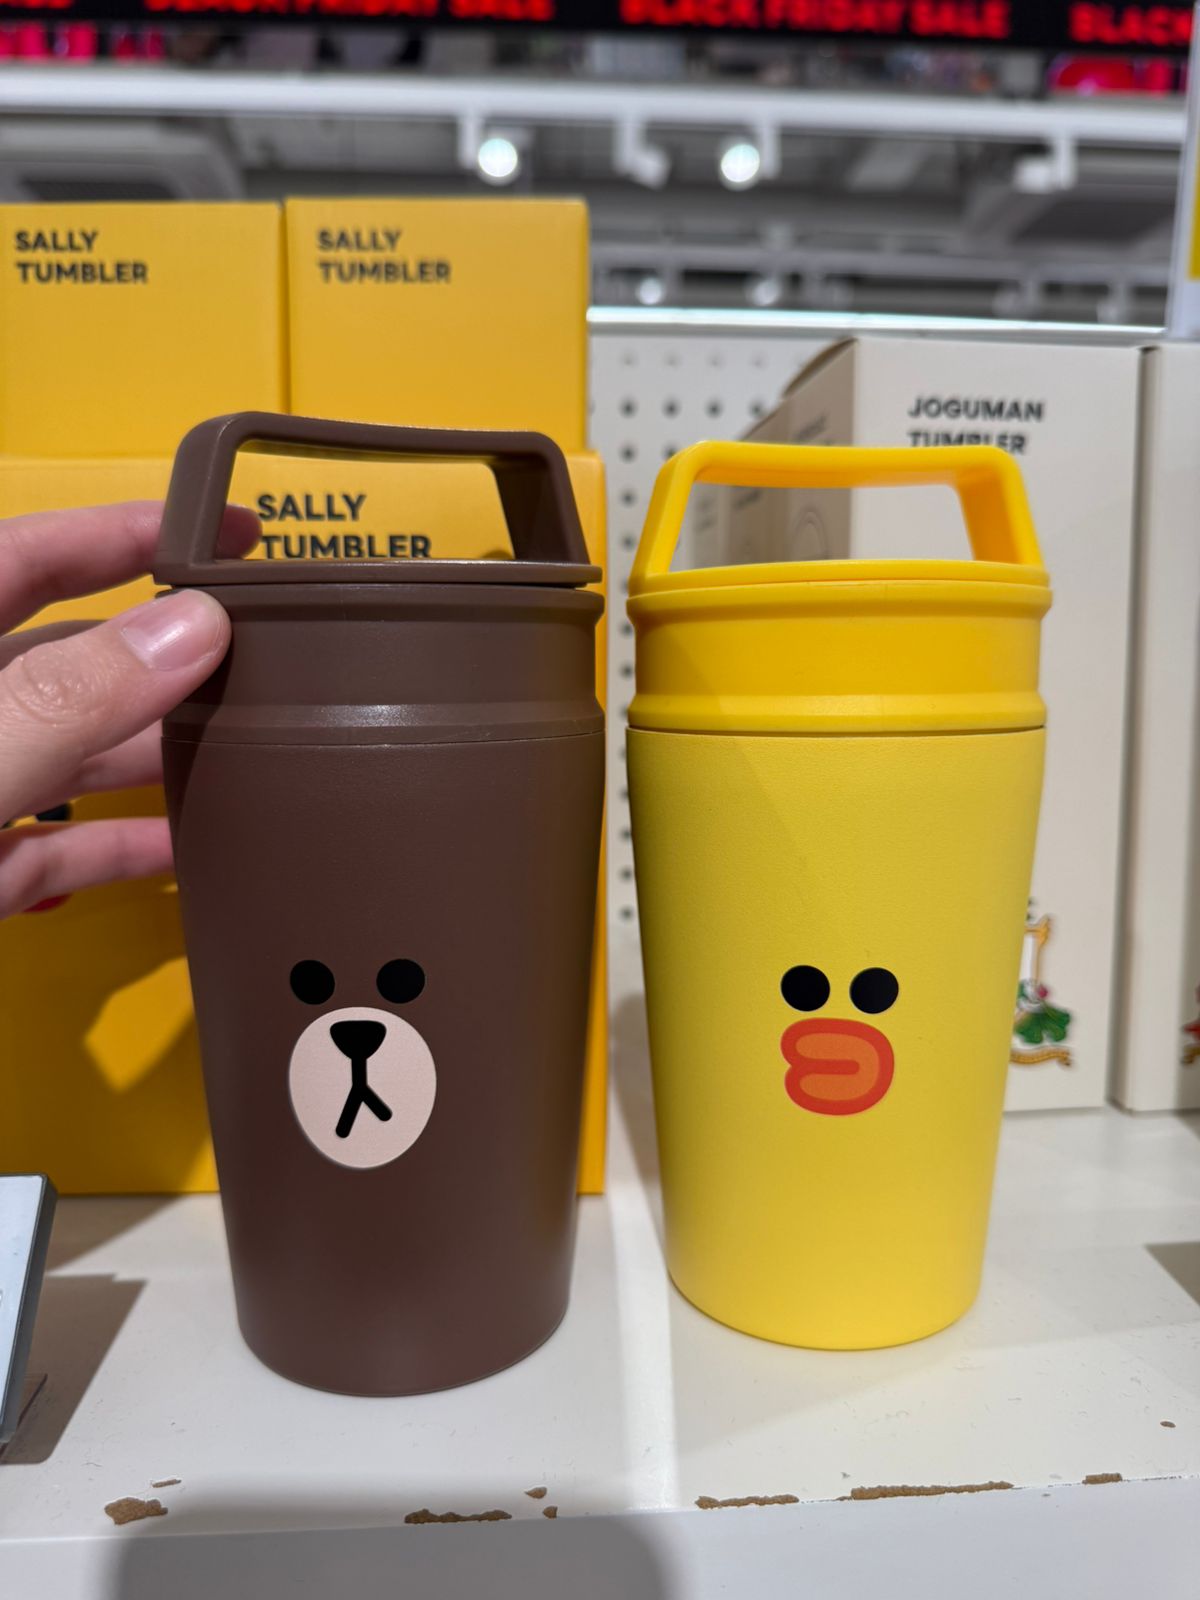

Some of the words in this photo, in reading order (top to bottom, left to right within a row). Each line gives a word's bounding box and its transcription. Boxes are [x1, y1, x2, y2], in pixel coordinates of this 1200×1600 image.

[15, 230, 98, 252] SALLY
[317, 229, 401, 251] SALLY
[15, 260, 148, 284] TUMBLER
[318, 260, 452, 284] TUMBLER
[908, 396, 1045, 421] JOGUMAN
[257, 493, 367, 521] SALLY
[261, 534, 432, 559] TUMBLER
